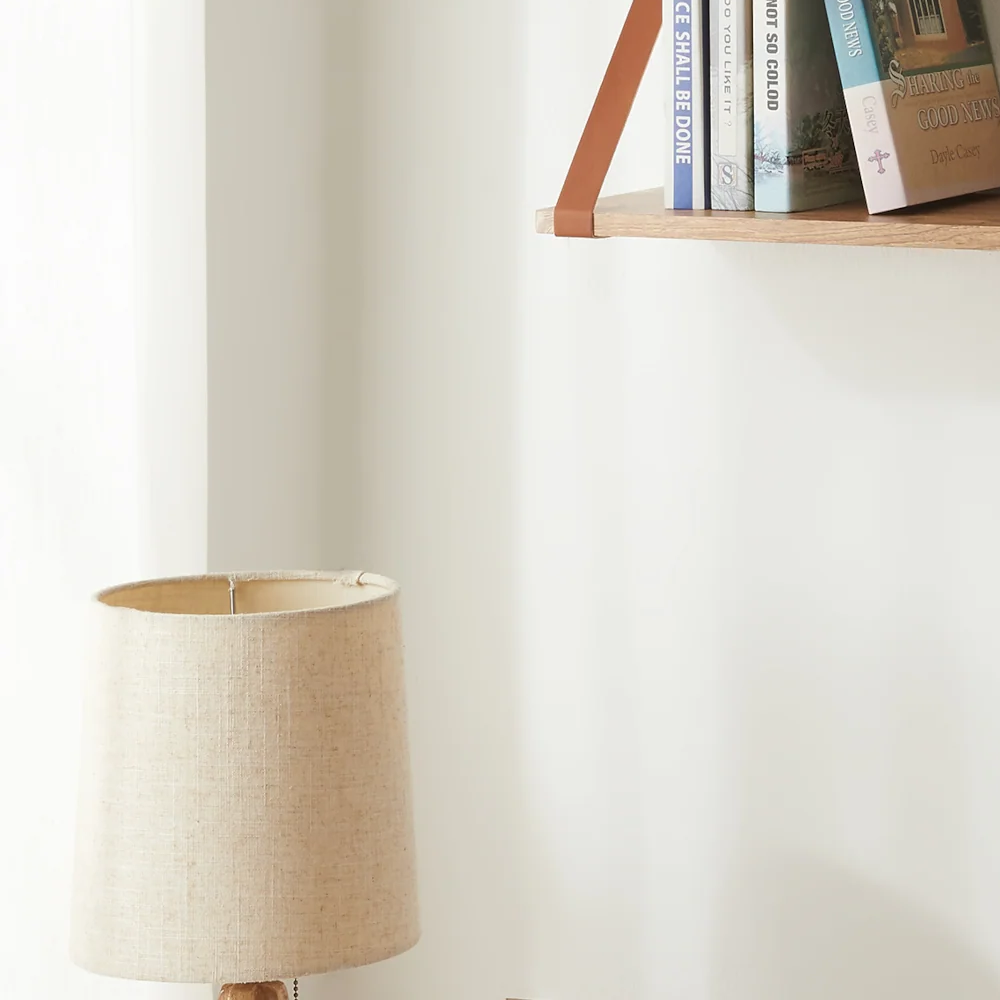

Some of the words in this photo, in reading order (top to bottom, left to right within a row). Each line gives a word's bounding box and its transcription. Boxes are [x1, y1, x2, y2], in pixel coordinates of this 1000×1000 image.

[766, 33, 778, 55] SO
[843, 21, 864, 58] NEWS
[675, 31, 691, 86] SHALL
[724, 61, 732, 94] LIKE
[766, 59, 779, 111] COLOD
[965, 69, 980, 85] the
[676, 90, 691, 111] BE
[724, 101, 731, 114] IT
[861, 95, 879, 134] Casey
[917, 104, 959, 131] GOOD
[961, 97, 1000, 124] NEWS
[676, 115, 691, 165] DONE
[930, 146, 955, 166] Dayle
[956, 143, 981, 160] Casey
